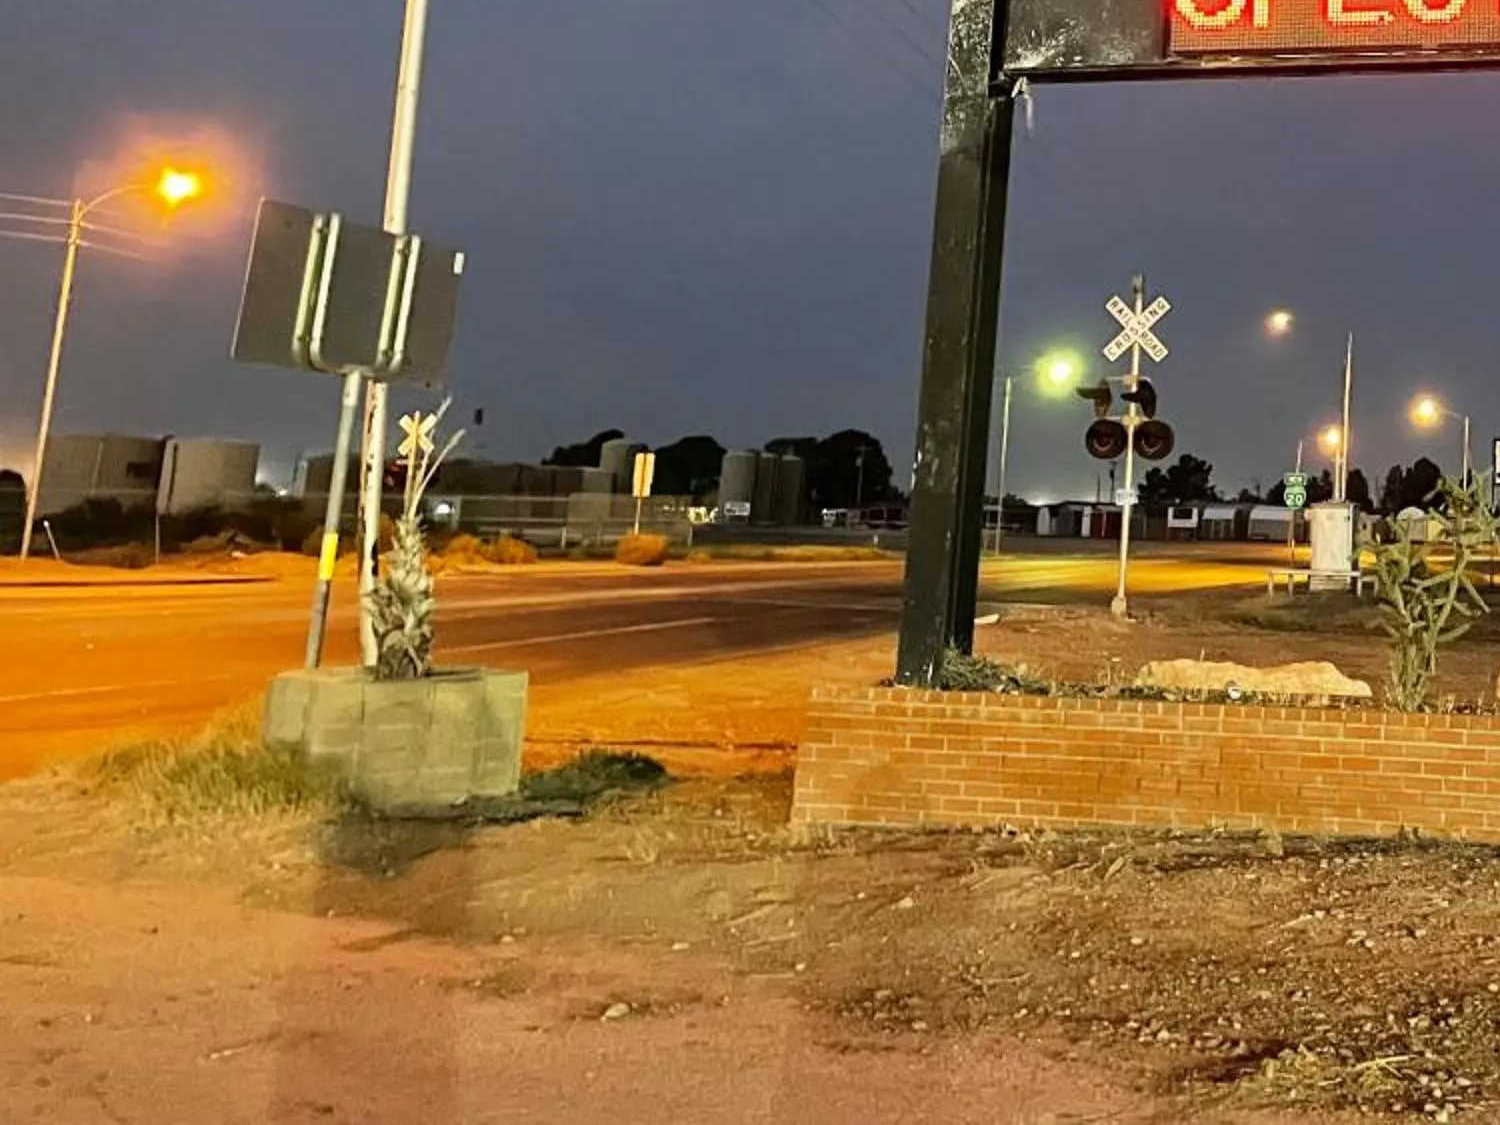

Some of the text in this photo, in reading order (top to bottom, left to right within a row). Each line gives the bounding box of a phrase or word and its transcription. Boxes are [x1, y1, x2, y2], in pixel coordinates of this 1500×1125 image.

[1109, 299, 1133, 326] RAIL
[1107, 299, 1167, 357] CROSSING
[1139, 331, 1165, 357] ROAD
